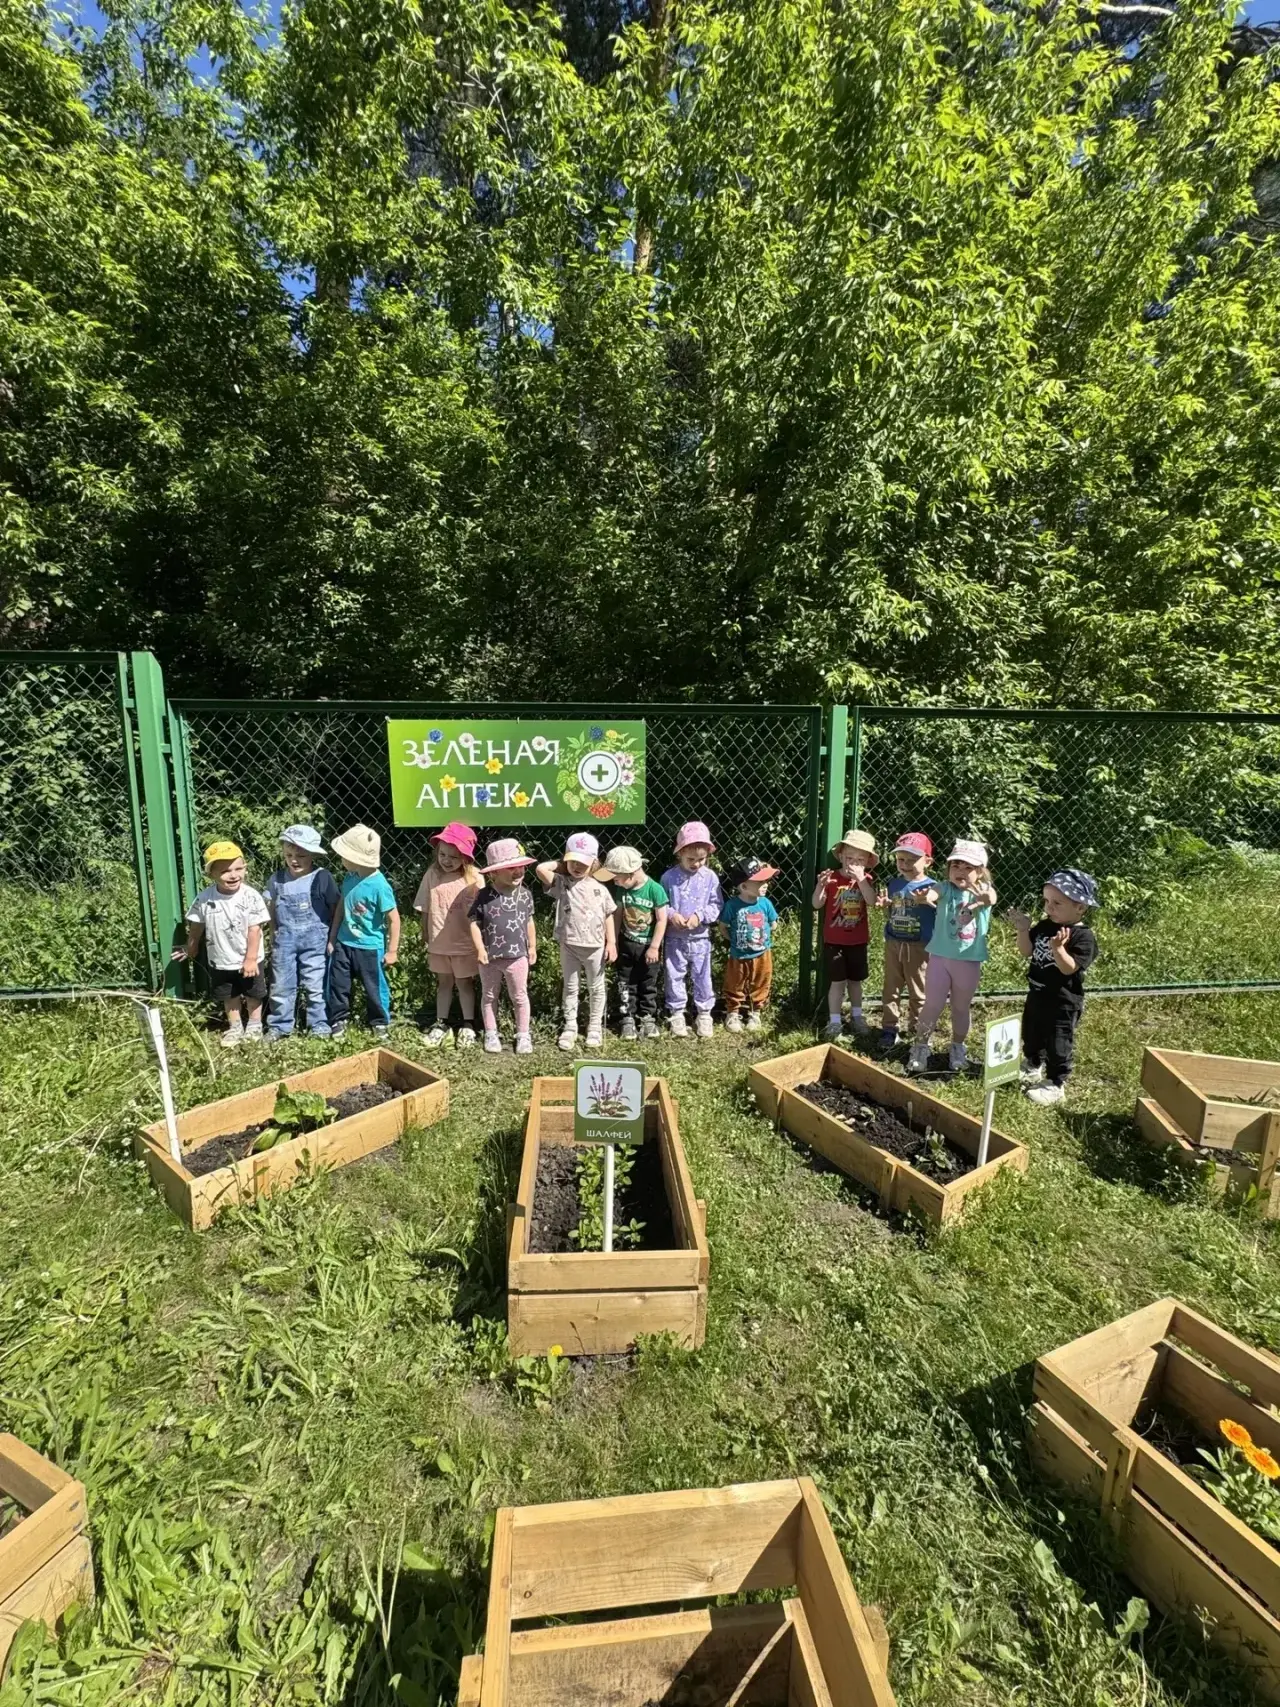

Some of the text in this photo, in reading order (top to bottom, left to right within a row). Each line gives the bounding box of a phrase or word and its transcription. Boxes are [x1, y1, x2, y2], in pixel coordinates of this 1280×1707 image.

[401, 739, 560, 767] ЗЕЛЕНАЯ
[416, 782, 552, 808] АПТЕКА
[586, 1129, 632, 1139] ШАЛФЕЙ
